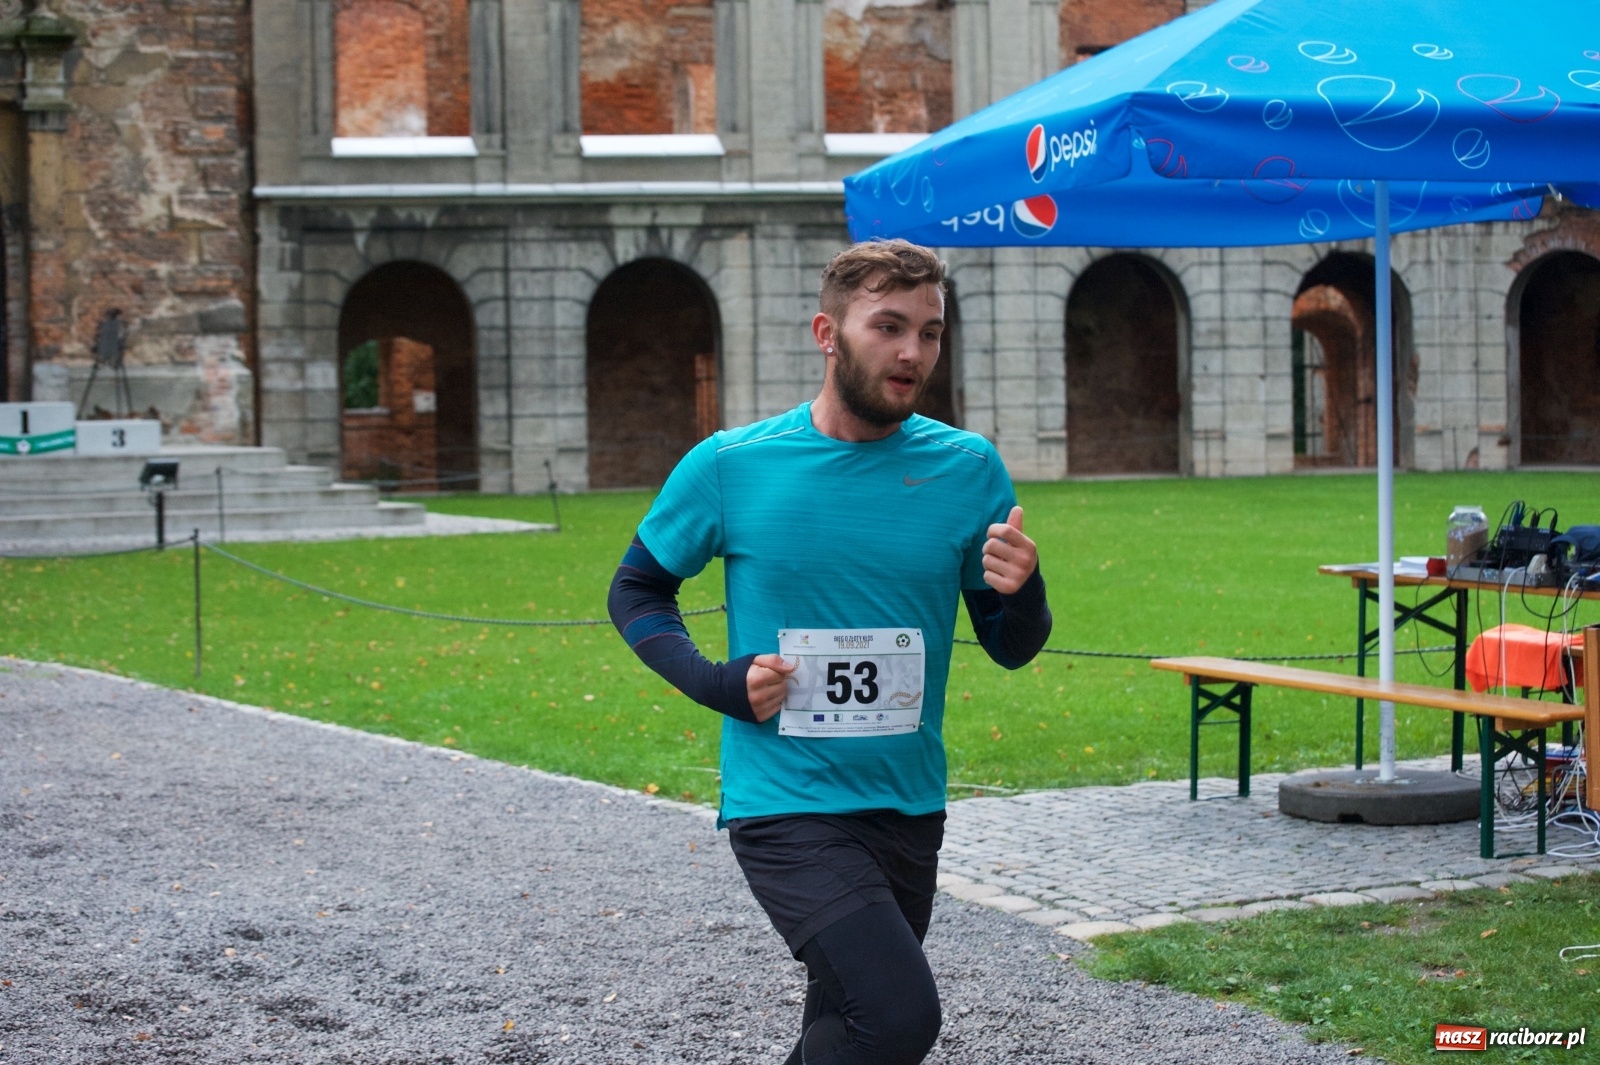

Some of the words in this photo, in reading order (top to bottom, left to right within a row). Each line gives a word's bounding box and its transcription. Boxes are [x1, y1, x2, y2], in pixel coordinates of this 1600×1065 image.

[1050, 119, 1097, 172] pepsi
[21, 410, 29, 434] 1
[112, 428, 125, 447] 3
[838, 641, 870, 649] 19.09.2021
[826, 661, 879, 705] 53
